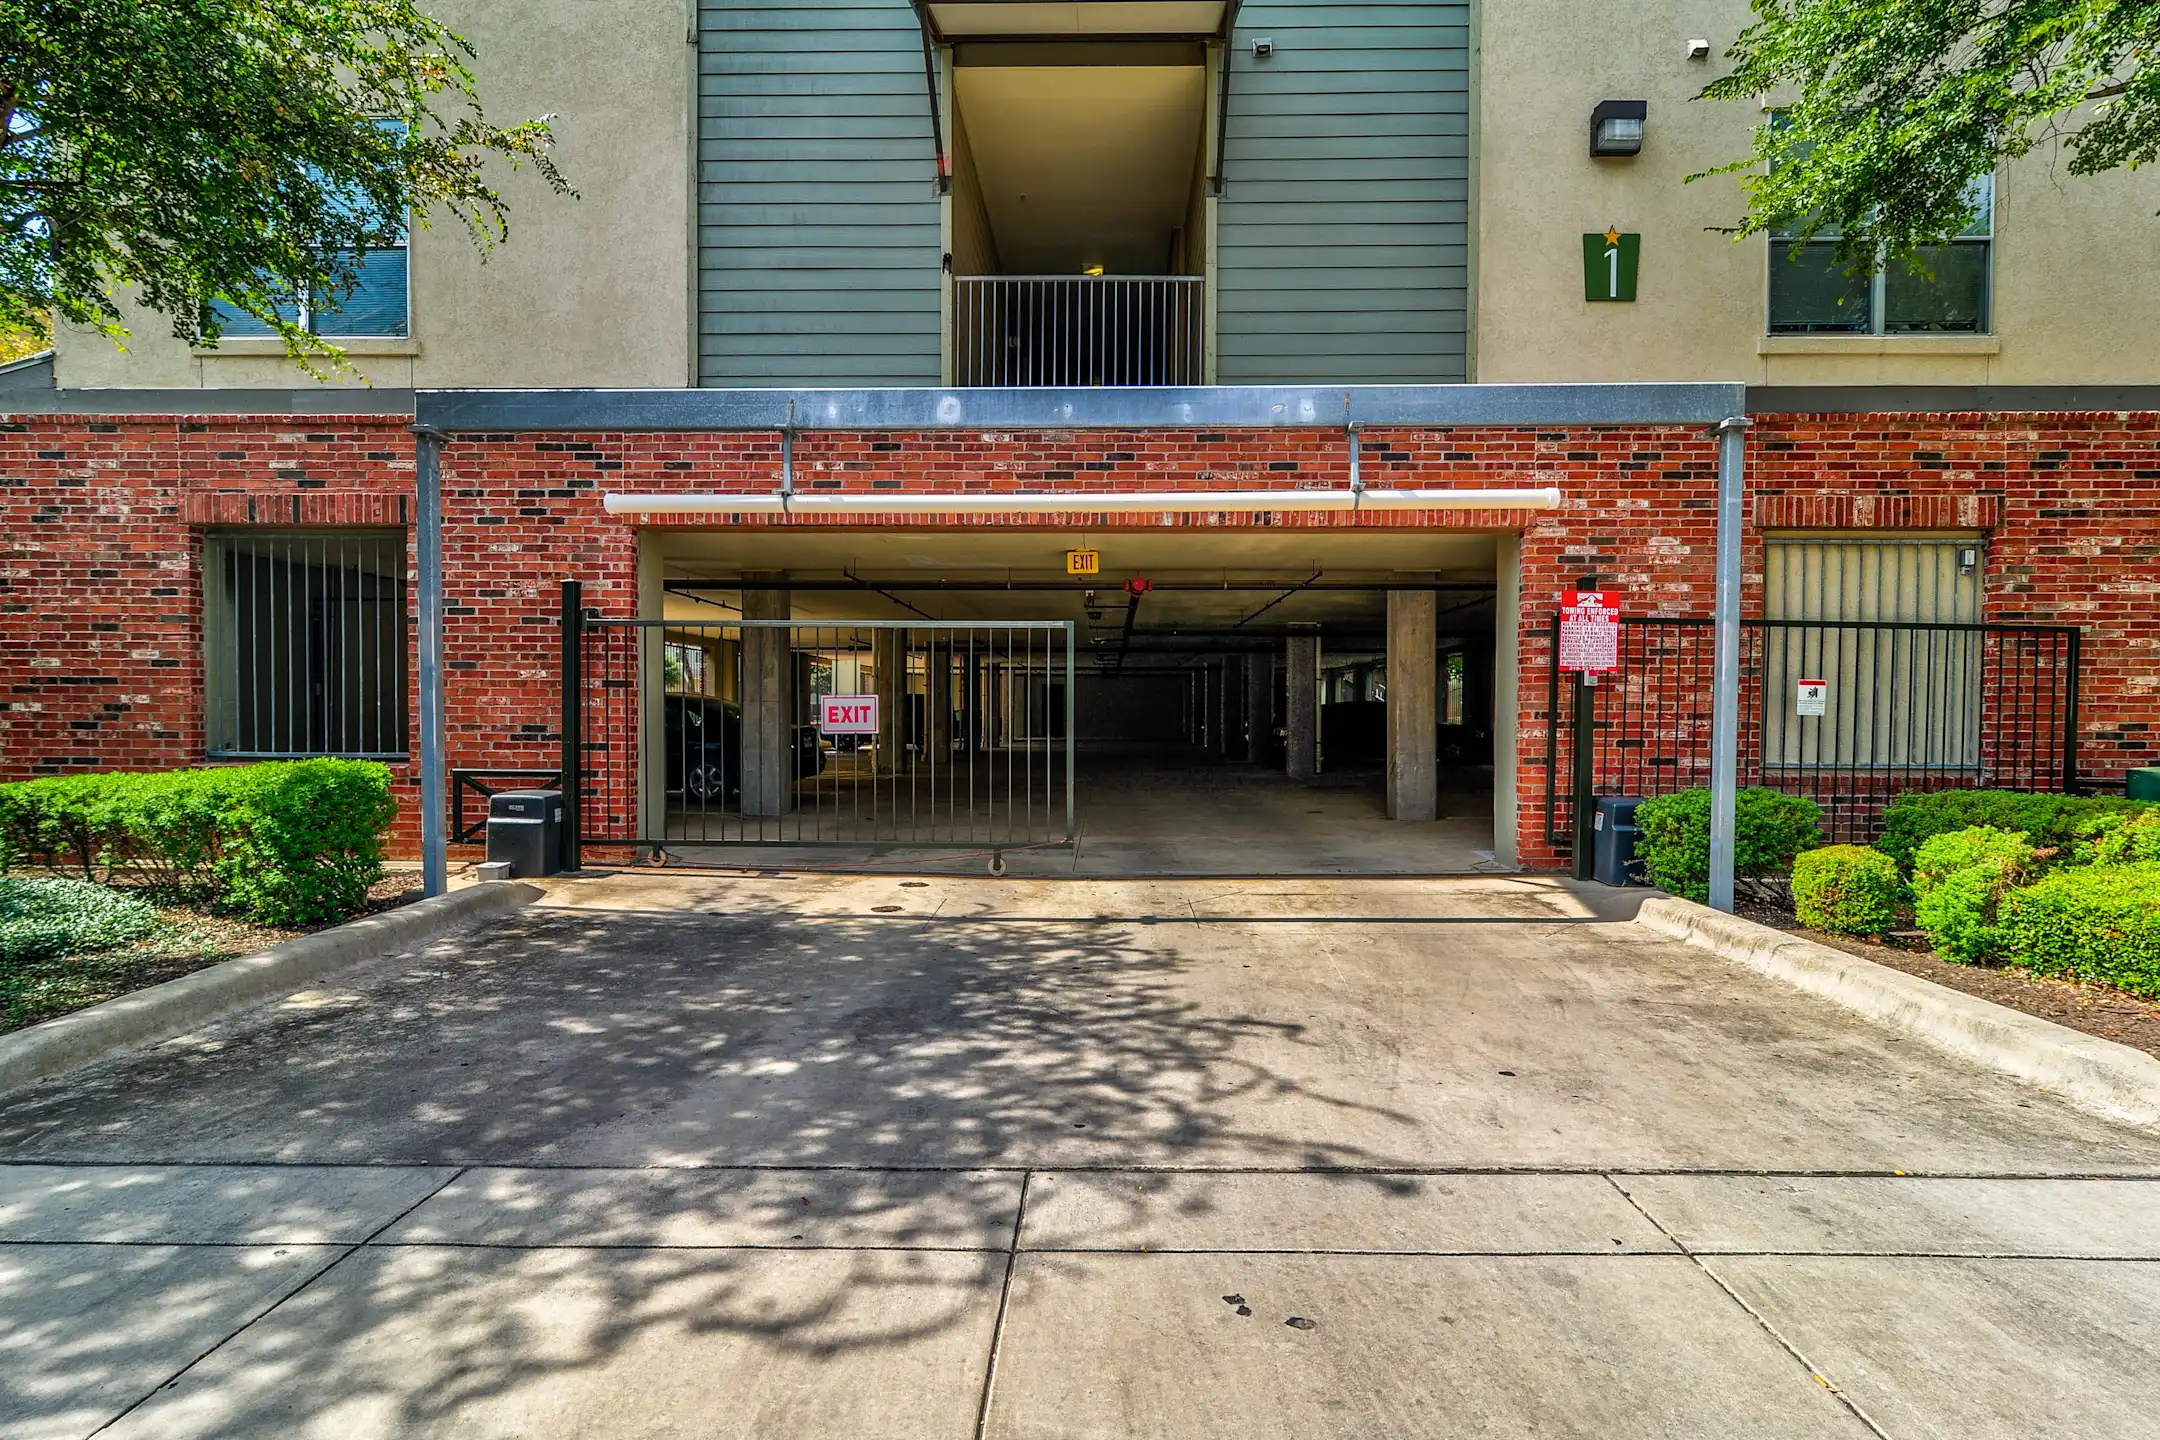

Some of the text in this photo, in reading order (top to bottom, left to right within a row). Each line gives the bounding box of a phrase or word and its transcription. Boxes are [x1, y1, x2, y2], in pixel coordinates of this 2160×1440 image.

[1604, 248, 1617, 297] 1
[1074, 554, 1093, 570] EXIT
[1587, 607, 1618, 615] ENFORCED
[828, 706, 871, 723] EXIT
